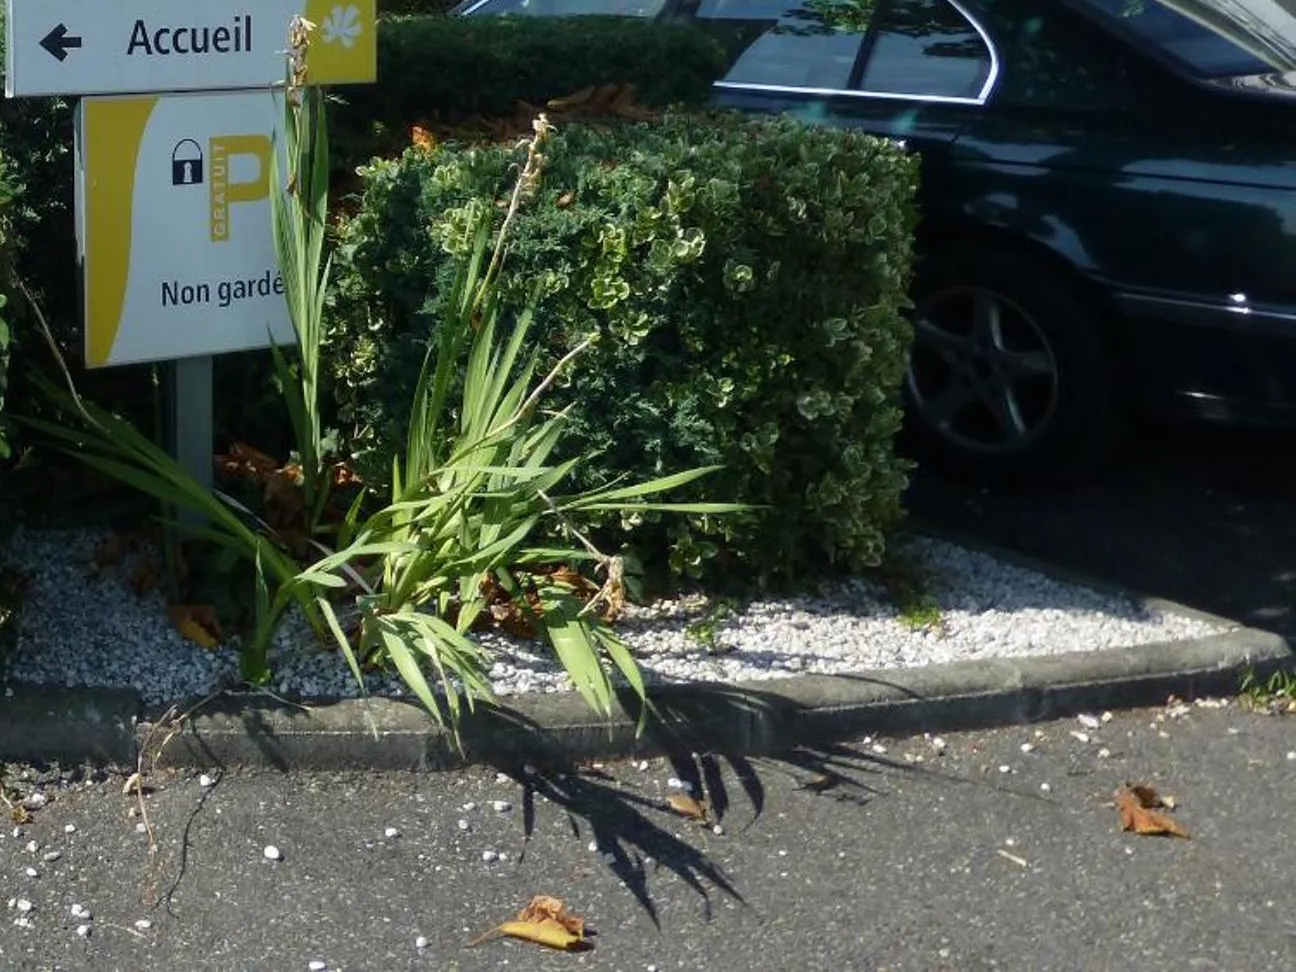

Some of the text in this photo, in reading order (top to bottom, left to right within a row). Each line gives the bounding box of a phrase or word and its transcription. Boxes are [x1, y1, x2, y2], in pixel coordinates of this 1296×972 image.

[127, 15, 252, 55] Accueil
[209, 134, 274, 242] P
[212, 143, 226, 235] GRATUIT
[161, 269, 287, 308] Non gardé
